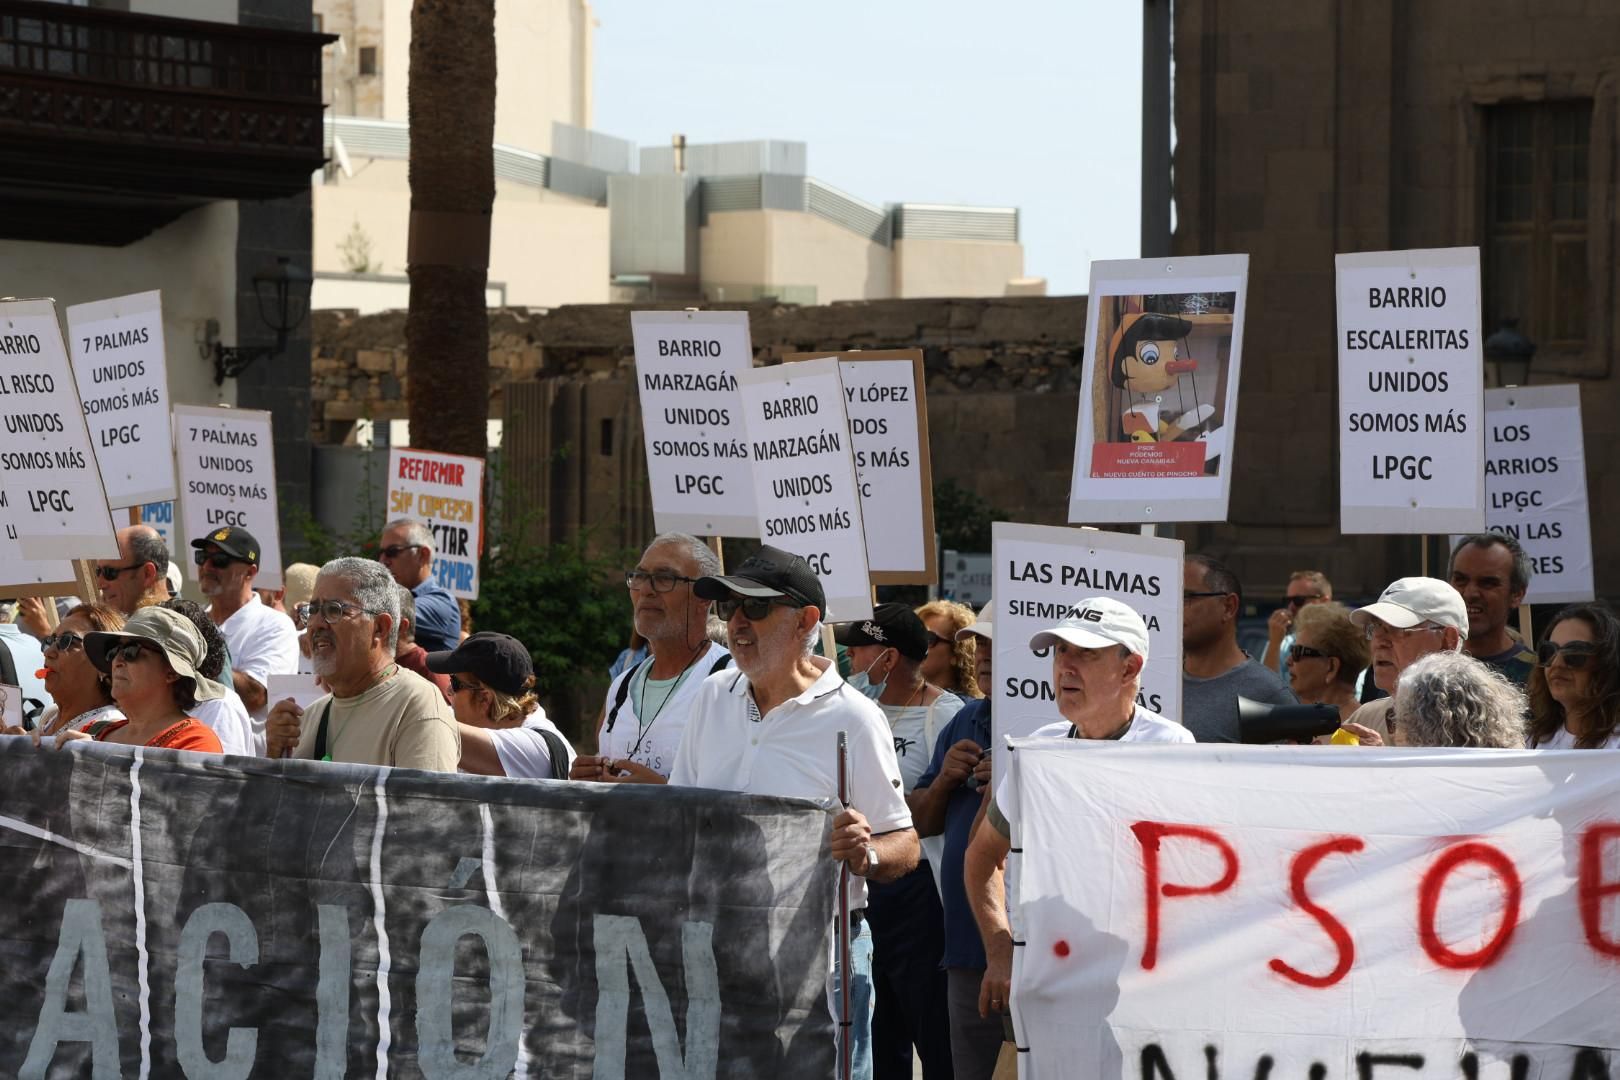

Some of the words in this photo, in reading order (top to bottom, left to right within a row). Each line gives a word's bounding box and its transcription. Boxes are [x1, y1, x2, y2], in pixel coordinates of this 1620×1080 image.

[1369, 287, 1446, 308] BARRIO
[0, 334, 40, 354] ARRIO
[83, 338, 91, 353] 7
[95, 327, 149, 351] PALMAS
[658, 340, 721, 357] BARRIO
[1347, 330, 1469, 350] ESCALERITAS
[93, 360, 145, 383] UNIDOS
[644, 371, 738, 391] MARZAGÁN
[0, 375, 10, 394] L
[11, 374, 54, 393] RISCO
[845, 387, 855, 402] Y
[860, 382, 908, 402] LÓPEZ
[1369, 372, 1448, 393] UNIDOS
[83, 394, 129, 415] SOMOS
[132, 387, 159, 407] MÁS
[763, 395, 819, 420] BARRIO
[4, 413, 64, 433] UNIDOS
[664, 408, 730, 426] UNIDOS
[848, 418, 888, 434] DOS
[1349, 413, 1419, 432] SOMOS
[1425, 409, 1467, 433] MÁS
[101, 424, 141, 447] LPGC
[189, 428, 197, 441] 7
[202, 429, 258, 447] PALMAS
[1494, 425, 1530, 442] LOS
[653, 441, 710, 457] SOMOS
[713, 439, 748, 458] MÁS
[753, 428, 841, 461] MARZAGÁN
[1, 452, 53, 470] SOMOS
[55, 447, 86, 469] MÁS
[199, 456, 253, 473] UNIDOS
[871, 447, 910, 467] MÁS
[1485, 457, 1558, 475] ARRIOS
[399, 457, 464, 487] REFORMAR
[1373, 456, 1432, 480] LPGC
[188, 481, 236, 497] SOMOS
[239, 483, 267, 500] MÁS
[675, 474, 724, 495] LPGC
[772, 474, 833, 499] UNIDOS
[28, 490, 74, 512] LPGC
[1492, 491, 1543, 508] LPGC
[207, 508, 247, 527] LPGC
[766, 515, 816, 537] SOMOS
[819, 507, 851, 531] MÁS
[1527, 523, 1562, 539] LAS
[802, 552, 832, 575] GC
[1009, 561, 1053, 584] LAS
[1061, 565, 1161, 596] PALMAS
[1009, 600, 1073, 619] SIEMP
[1006, 677, 1055, 701] SOM
[1136, 687, 1162, 714] ÁS
